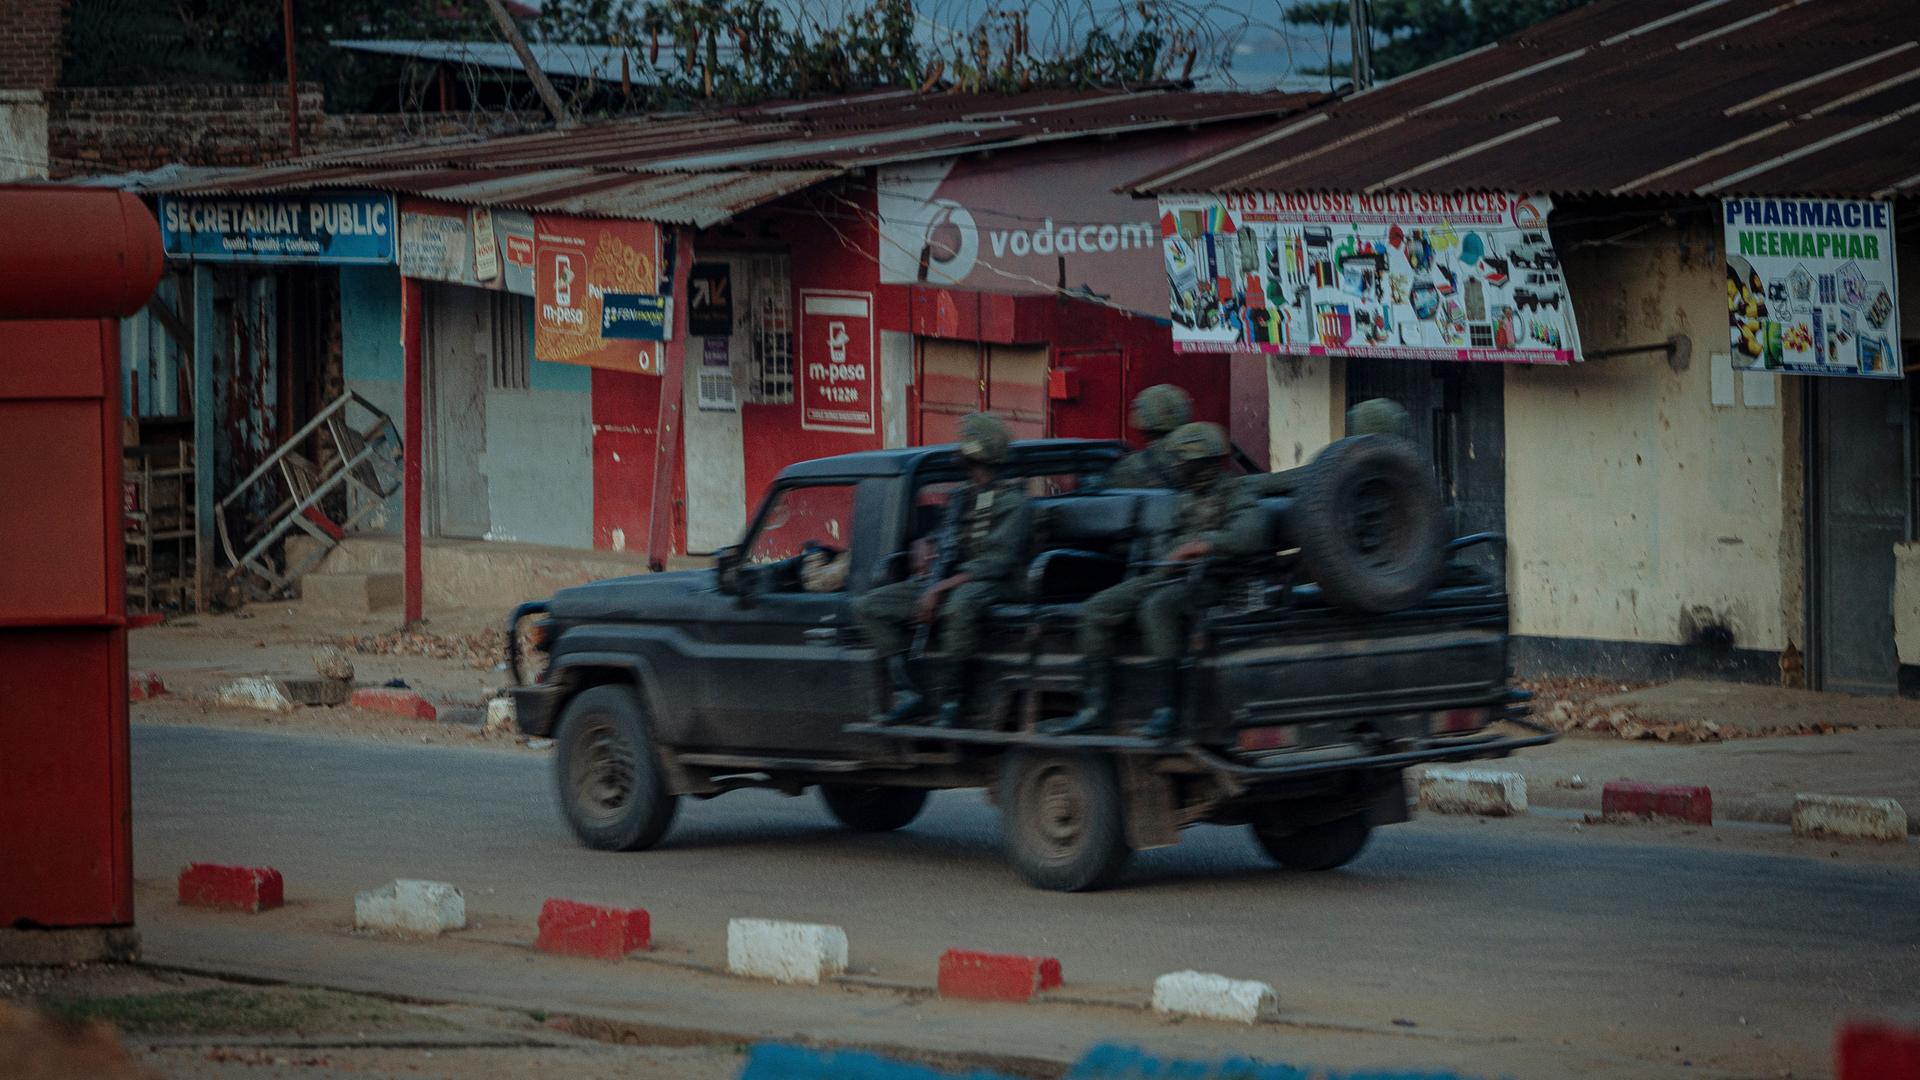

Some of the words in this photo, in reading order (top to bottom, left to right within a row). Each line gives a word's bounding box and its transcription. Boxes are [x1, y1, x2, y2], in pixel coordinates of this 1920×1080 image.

[1225, 193, 1257, 212] ETS
[1262, 193, 1355, 214] LAROUSSE
[1359, 193, 1508, 214] MULTI-SERVICES
[1726, 200, 1887, 229] PHARMACIE
[166, 201, 301, 234] SECRETARIAT
[310, 203, 387, 236] PUBLIC
[989, 216, 1154, 257] vodacom
[1738, 231, 1880, 260] NEEMAPHAR
